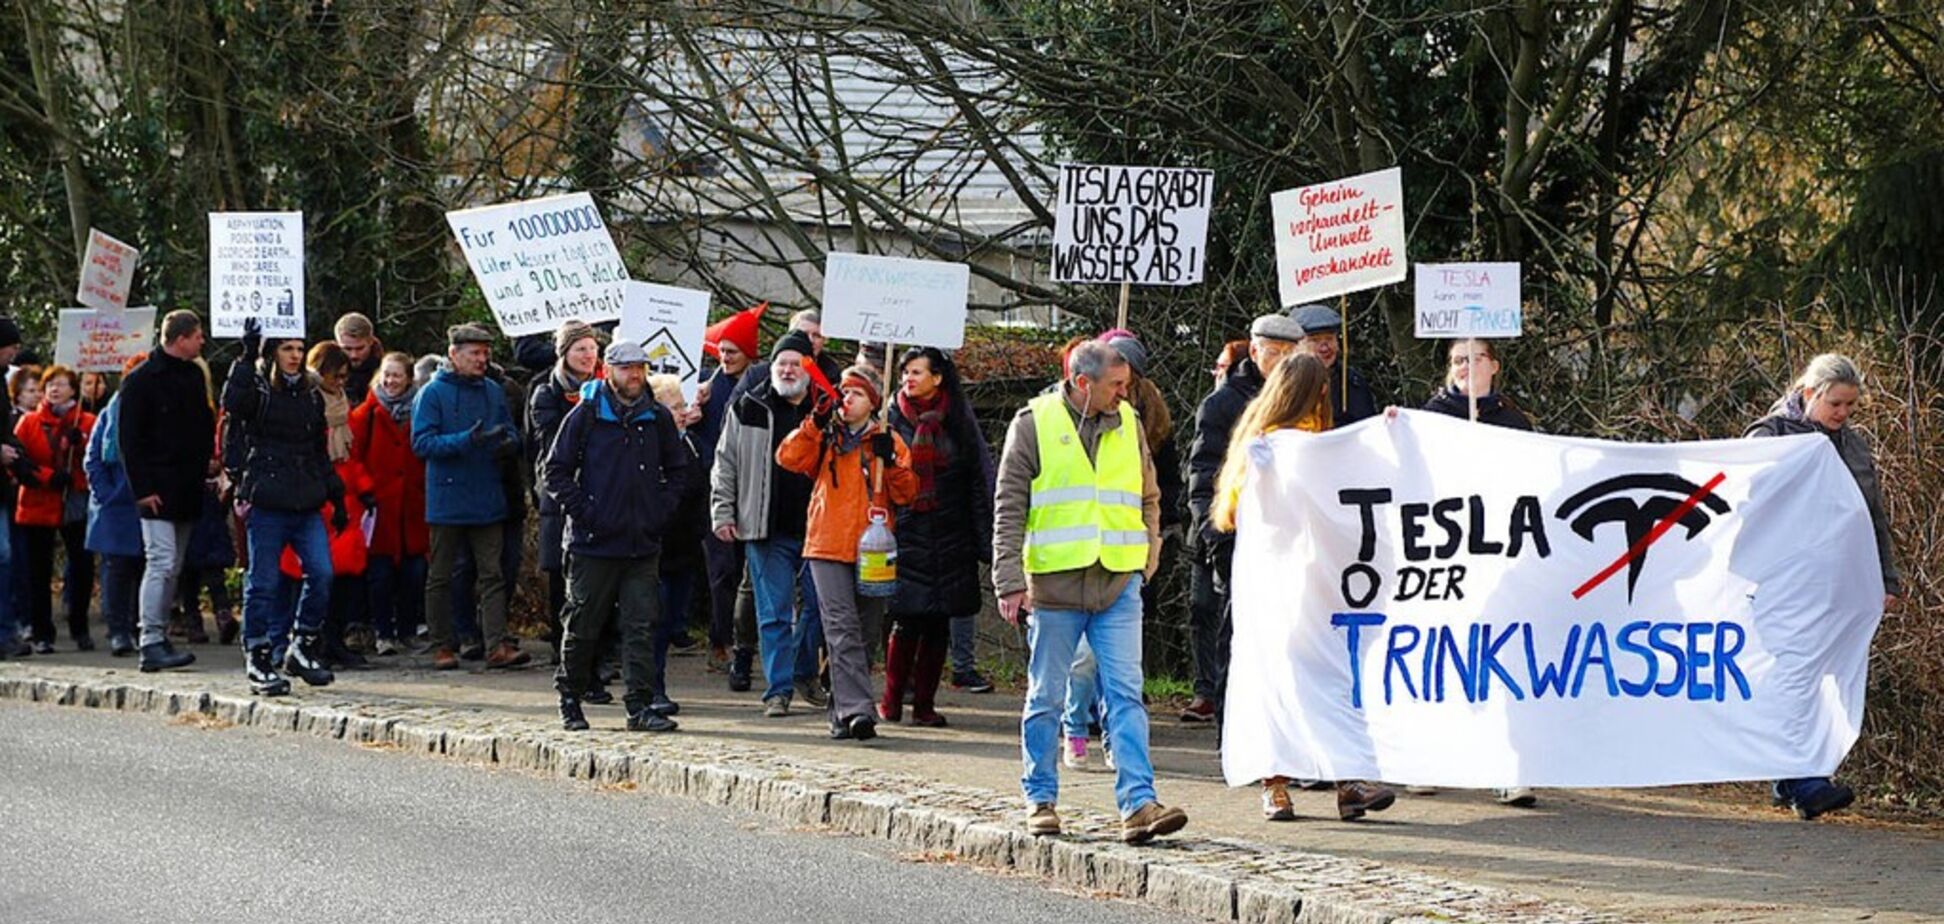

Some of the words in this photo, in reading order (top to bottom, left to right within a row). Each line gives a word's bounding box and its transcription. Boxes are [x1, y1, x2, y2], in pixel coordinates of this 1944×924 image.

[1064, 165, 1132, 205] TESLA
[1136, 168, 1214, 208] GRÄBT
[1299, 184, 1364, 215] Geheim
[508, 204, 602, 242] 10000000
[1073, 205, 1124, 246] UNS
[1130, 204, 1179, 246] DAS
[1308, 225, 1373, 254] Umwelt
[494, 280, 524, 300] und
[585, 260, 628, 284] Wald
[1054, 243, 1139, 282] WASSER
[1437, 268, 1491, 287] TESLA
[857, 311, 916, 339] TESLA
[1420, 309, 1460, 329] NICHT
[1338, 487, 1551, 563] TESLA
[1331, 612, 1752, 709] TRINKWASSER
